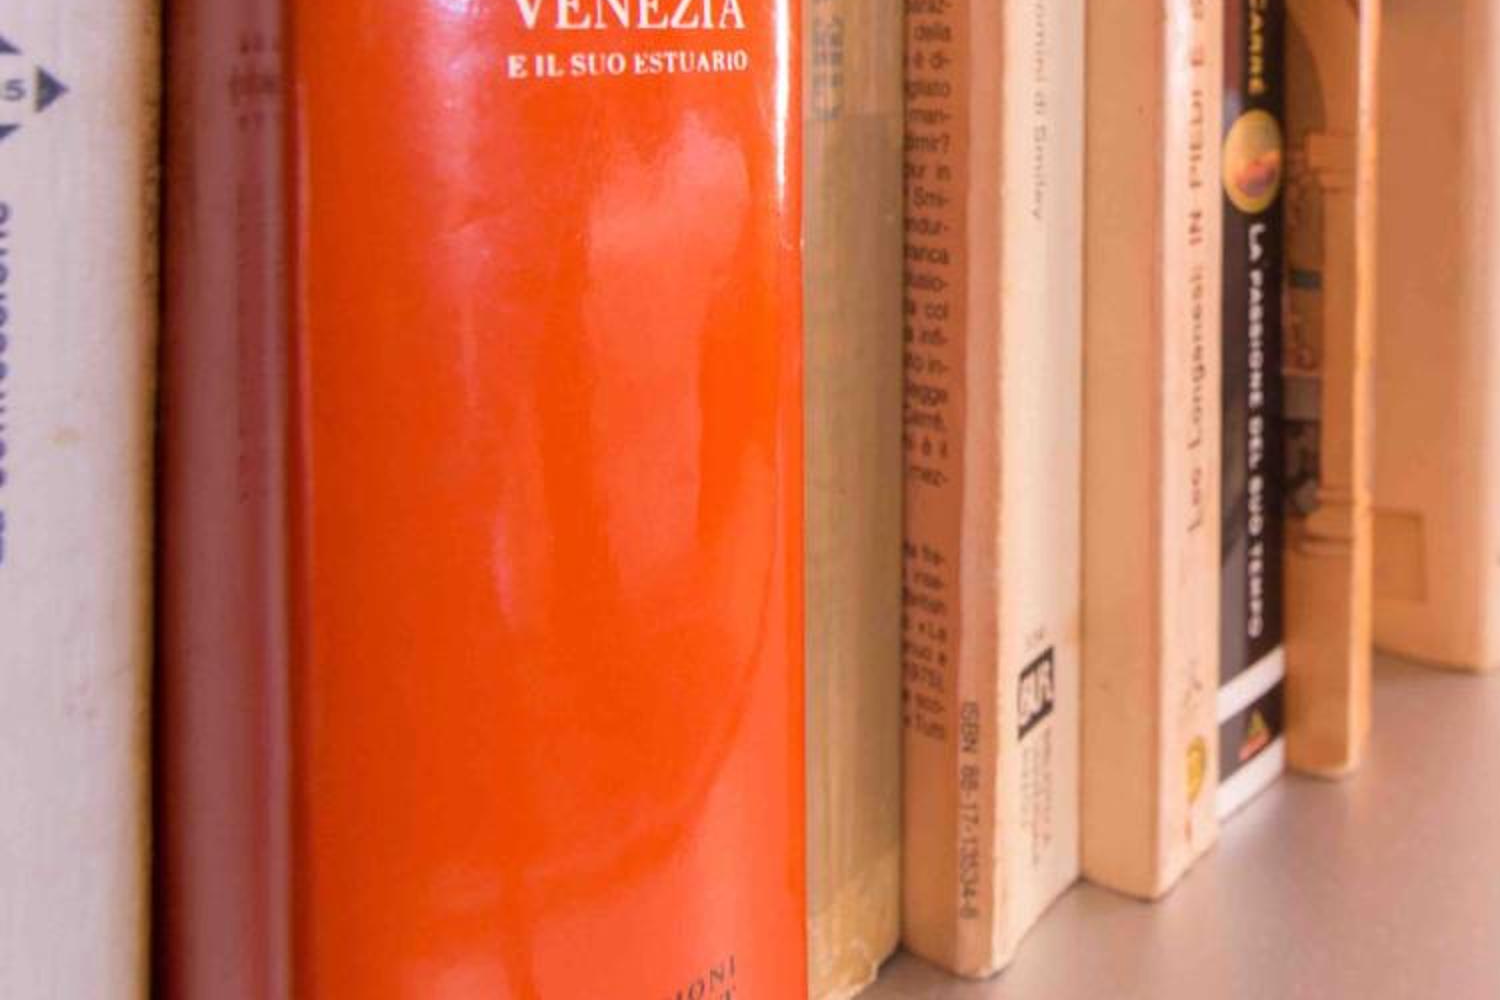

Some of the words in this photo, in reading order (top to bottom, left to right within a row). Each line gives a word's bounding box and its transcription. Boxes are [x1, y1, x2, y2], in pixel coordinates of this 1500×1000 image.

[508, 54, 528, 80] E
[534, 53, 564, 78] IL
[570, 51, 627, 76] SUO
[634, 48, 749, 75] ESTUARIO
[1247, 266, 1265, 409] PASSIONE
[1186, 466, 1204, 530] Leo
[1247, 472, 1265, 534] SUO
[1247, 538, 1265, 638] TEMPO
[958, 700, 980, 756] ISBN
